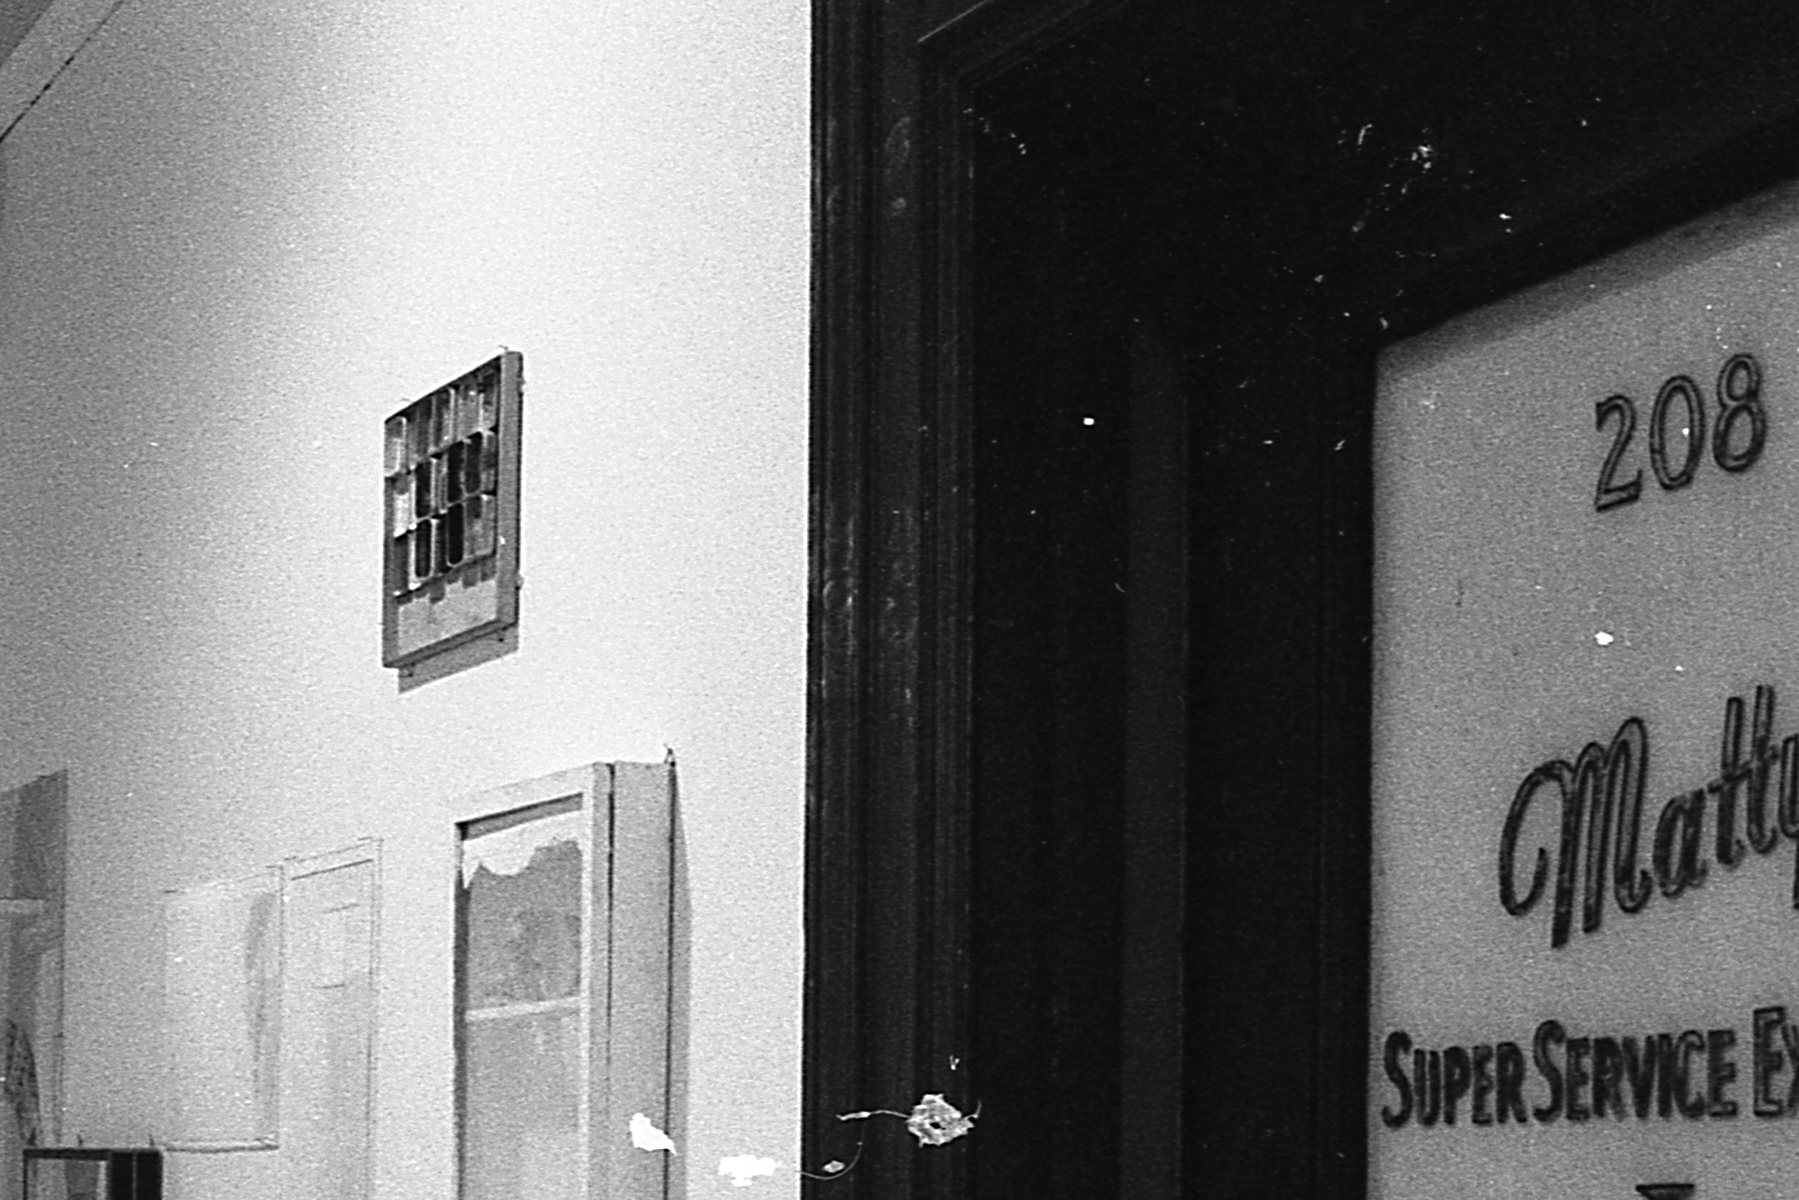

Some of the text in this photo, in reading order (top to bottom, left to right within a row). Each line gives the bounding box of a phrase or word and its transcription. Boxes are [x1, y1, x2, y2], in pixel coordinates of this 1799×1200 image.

[1594, 352, 1766, 512] 208
[1381, 1030, 1527, 1129] SUPER
[1532, 1019, 1738, 1123] SERVICE
